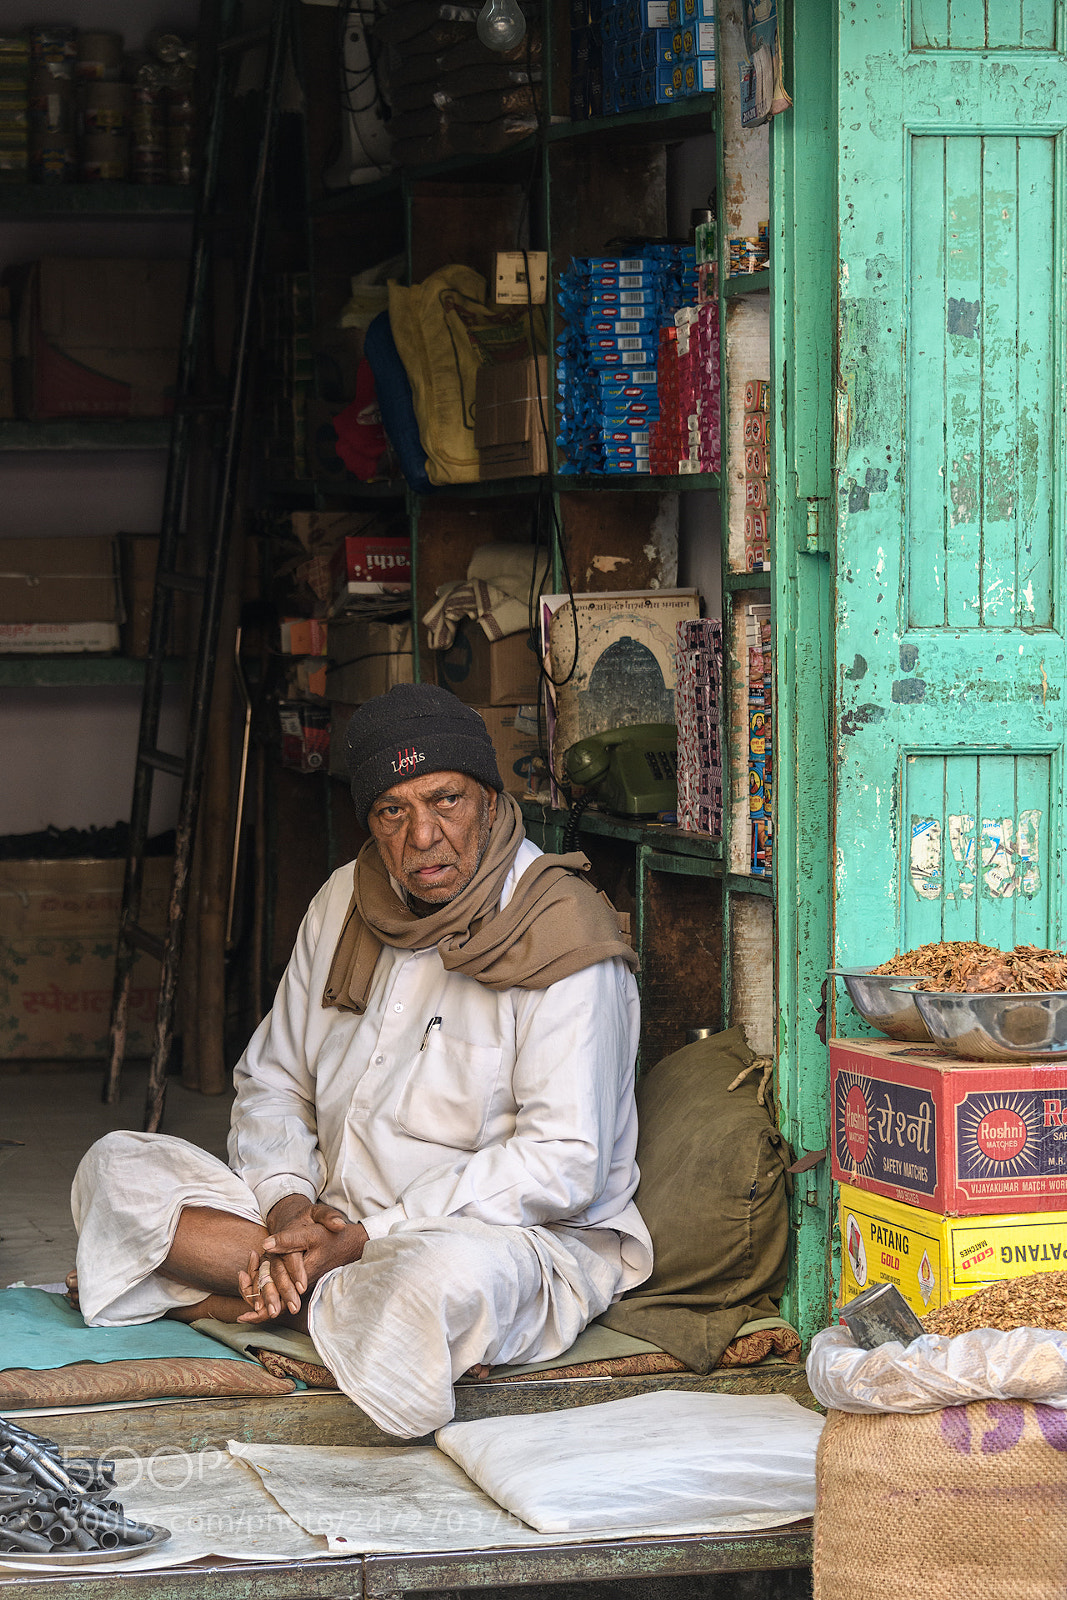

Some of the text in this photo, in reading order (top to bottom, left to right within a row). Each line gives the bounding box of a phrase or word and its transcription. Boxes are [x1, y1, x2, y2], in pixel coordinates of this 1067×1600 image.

[366, 555, 411, 570] athi
[846, 1102, 868, 1131] Roshni
[981, 1121, 1023, 1139] Roshni
[987, 1140, 1018, 1149] MATCHES
[883, 1157, 928, 1183] SAFETY MATCHES
[971, 1182, 1019, 1194] VIJAYAKUMAR
[1022, 1181, 1046, 1192] MATCH
[870, 1222, 909, 1255] PATANG
[959, 1240, 988, 1258] MATCHES
[962, 1247, 994, 1270] GOLD
[881, 1251, 900, 1271] GOLD
